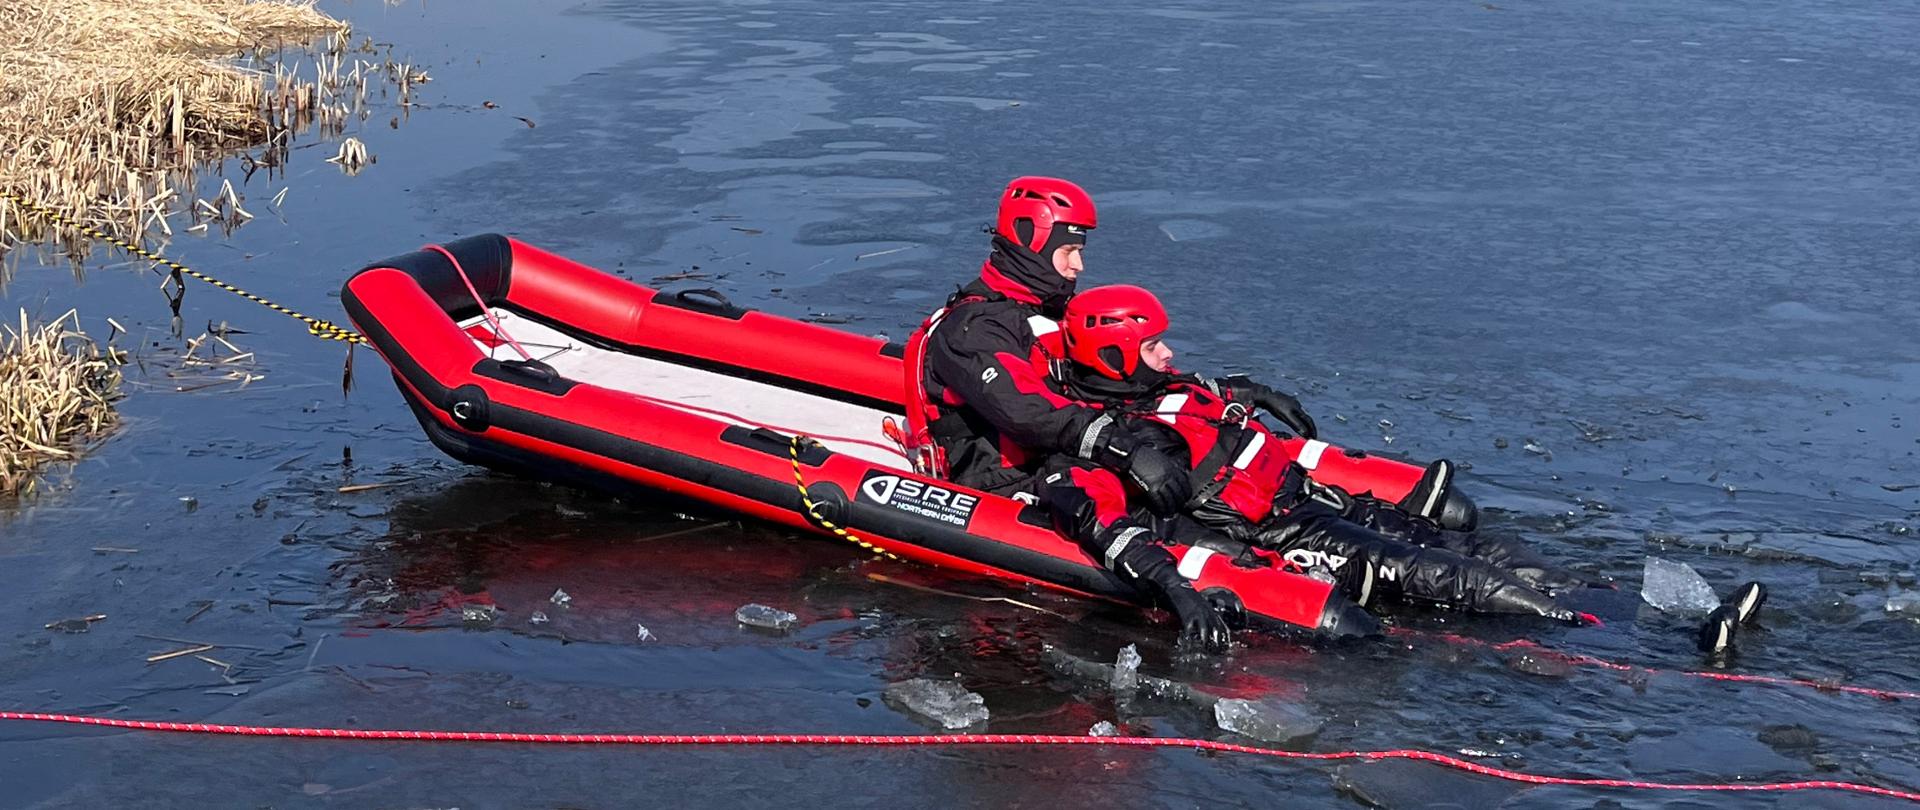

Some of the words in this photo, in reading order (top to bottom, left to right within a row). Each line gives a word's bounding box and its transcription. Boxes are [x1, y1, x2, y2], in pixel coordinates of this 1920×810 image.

[894, 479, 977, 513] SRE
[896, 501, 941, 520] NORTHERN
[940, 512, 966, 526] DIVER
